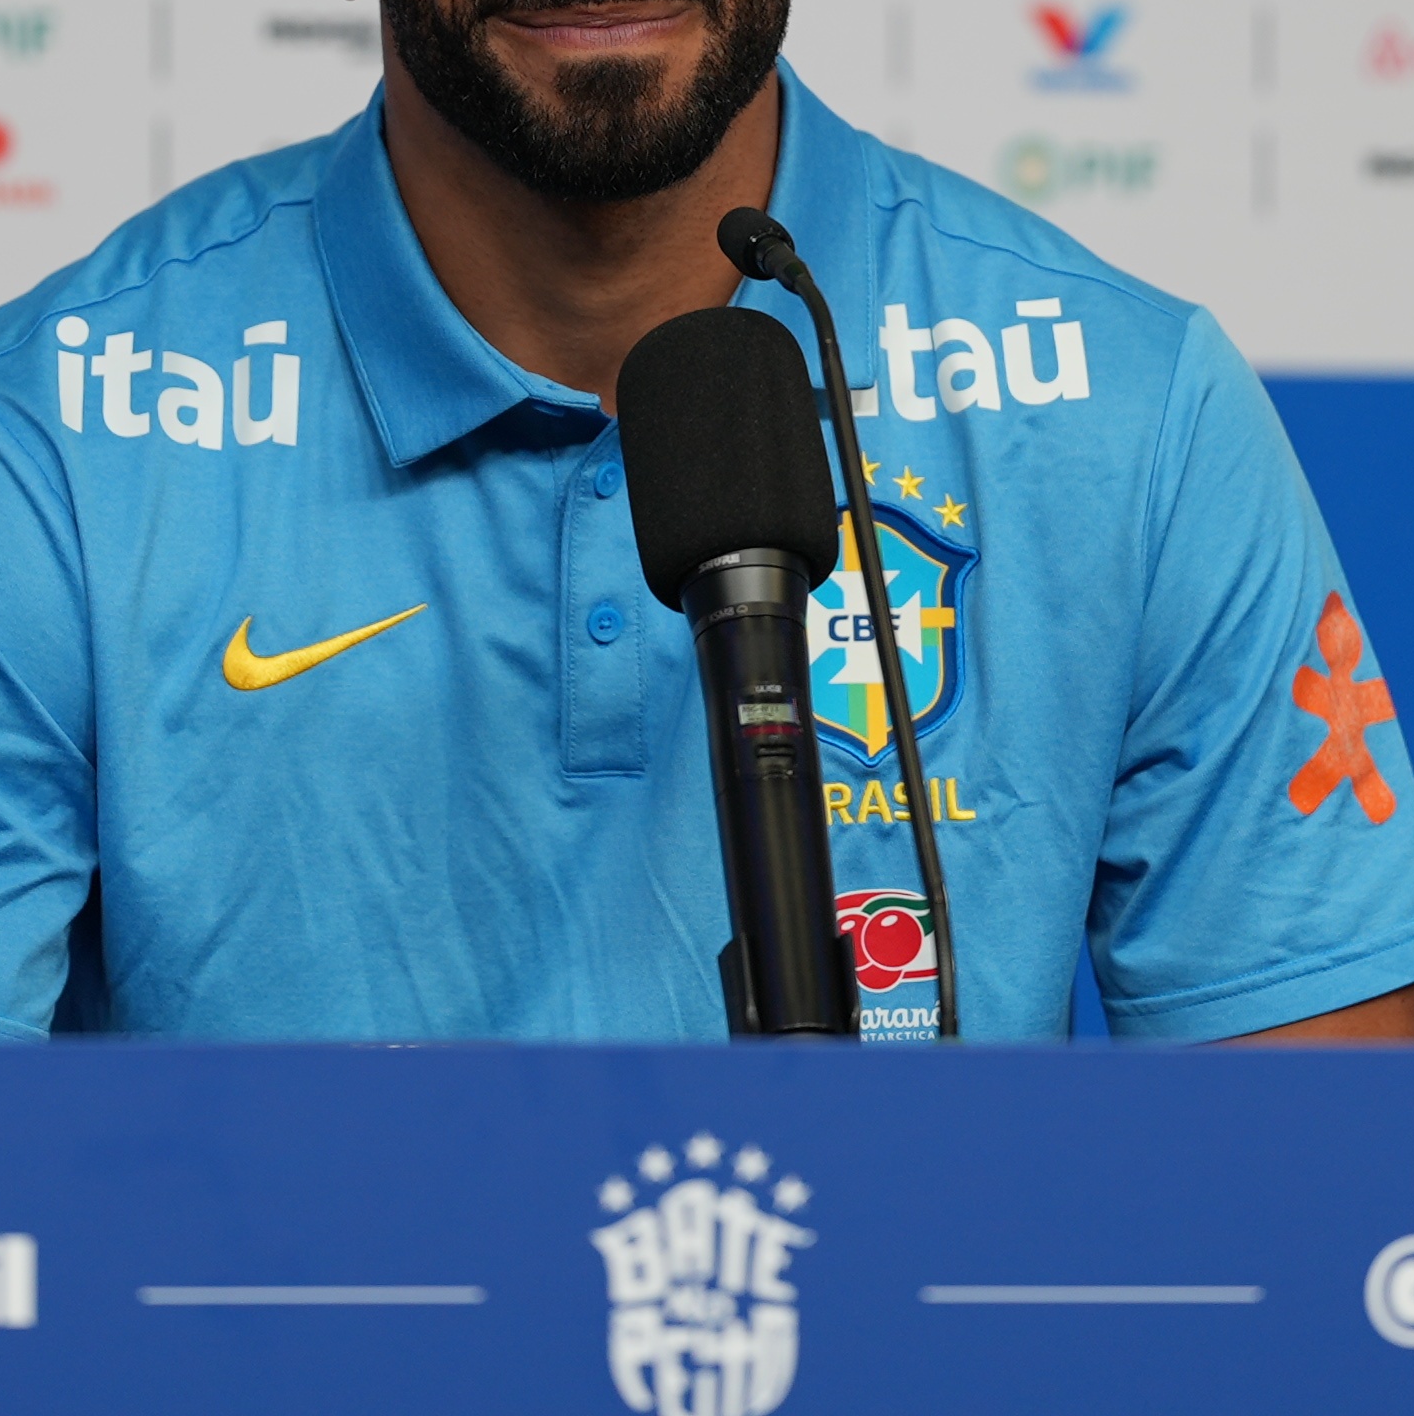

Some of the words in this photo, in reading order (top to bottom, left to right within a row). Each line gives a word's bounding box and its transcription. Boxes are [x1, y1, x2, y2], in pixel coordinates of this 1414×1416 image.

[56, 316, 300, 450] itaú
[851, 297, 1089, 421] taú
[823, 777, 976, 825] RASIL
[860, 1030, 936, 1043] NTARCTICA
[590, 1179, 818, 1304] BATE
